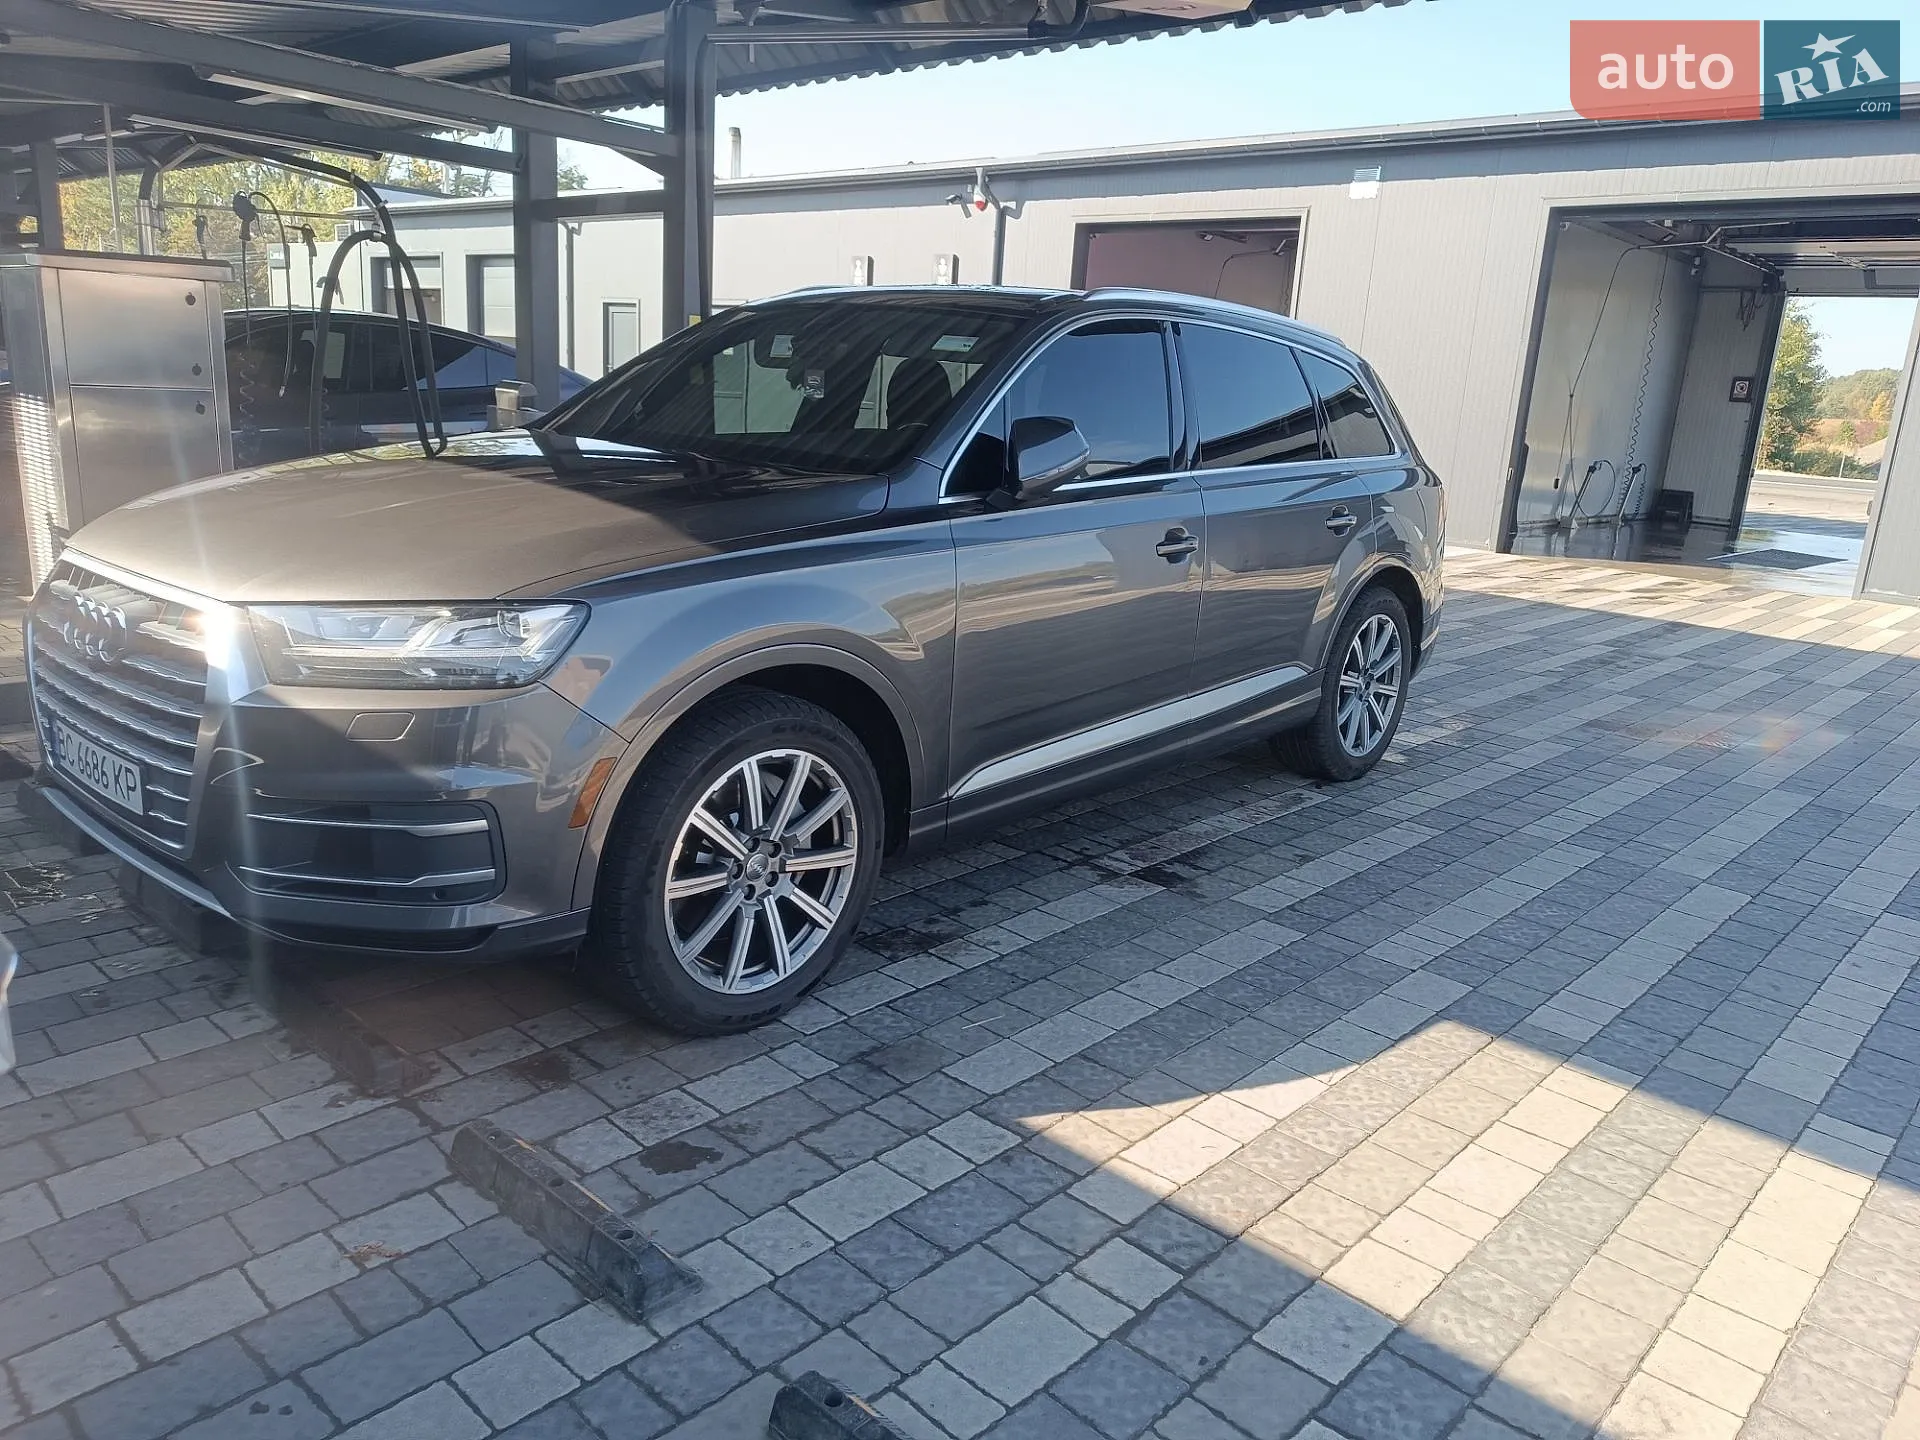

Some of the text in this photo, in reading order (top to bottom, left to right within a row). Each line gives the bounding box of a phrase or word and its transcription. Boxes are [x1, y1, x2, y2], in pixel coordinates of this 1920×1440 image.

[57, 725, 137, 801] BC 6686 KP
